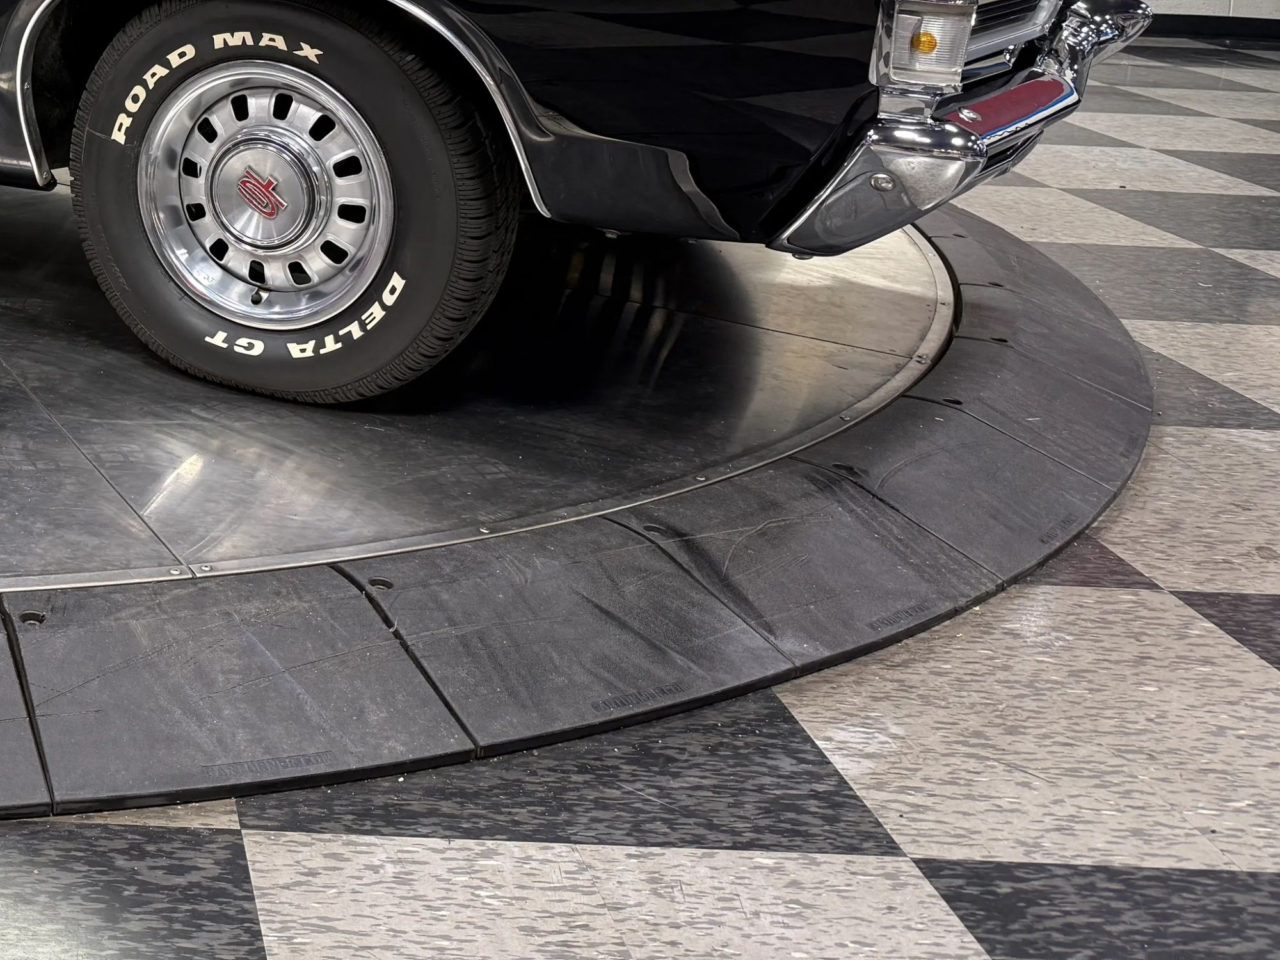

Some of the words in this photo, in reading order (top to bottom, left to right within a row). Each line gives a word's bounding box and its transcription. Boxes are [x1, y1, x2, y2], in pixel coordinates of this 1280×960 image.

[111, 43, 196, 145] ROAD
[212, 31, 324, 64] MAX
[204, 329, 265, 357] GT
[286, 271, 407, 359] DELTA
